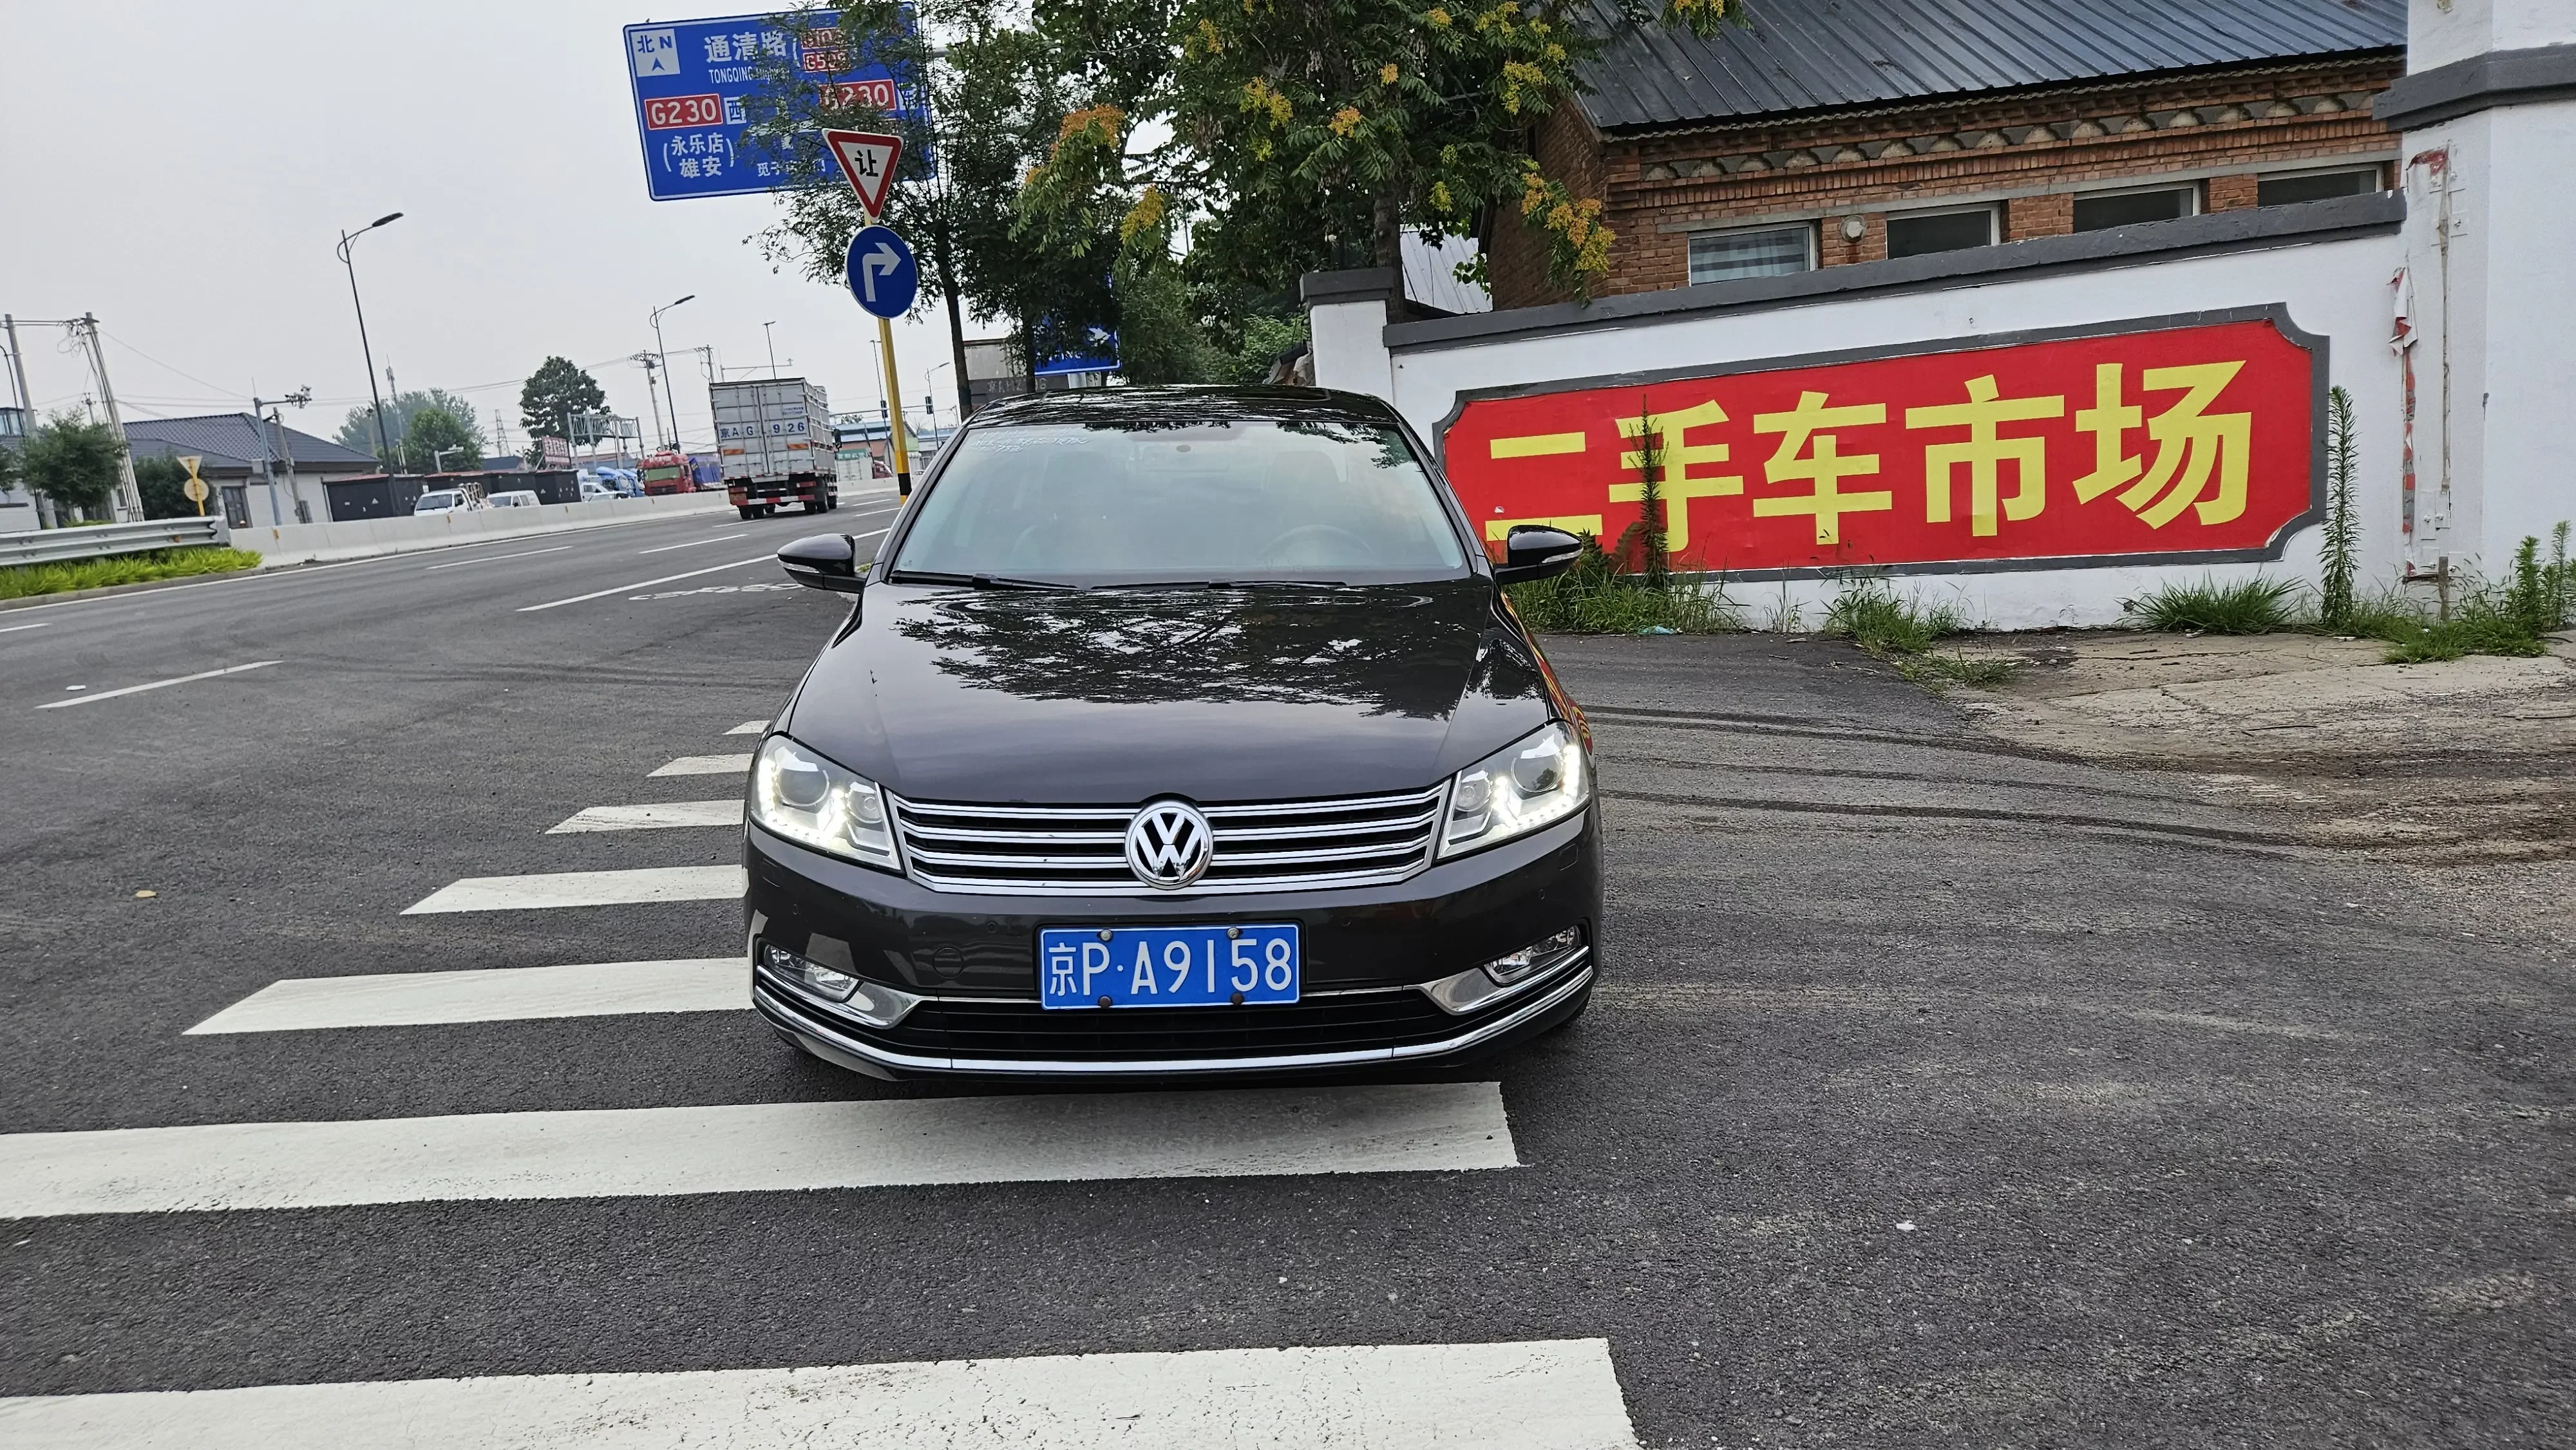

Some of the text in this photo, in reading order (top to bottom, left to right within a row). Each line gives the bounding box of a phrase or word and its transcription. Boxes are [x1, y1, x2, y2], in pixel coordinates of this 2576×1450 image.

[637, 35, 673, 53] 北 N
[704, 30, 786, 63] 通清路
[651, 99, 716, 125] G230
[726, 100, 743, 121] 西
[670, 132, 724, 156] 永乐店
[679, 156, 722, 178] 雄安
[855, 149, 878, 177] 让
[1484, 359, 2252, 554] 二手车市场
